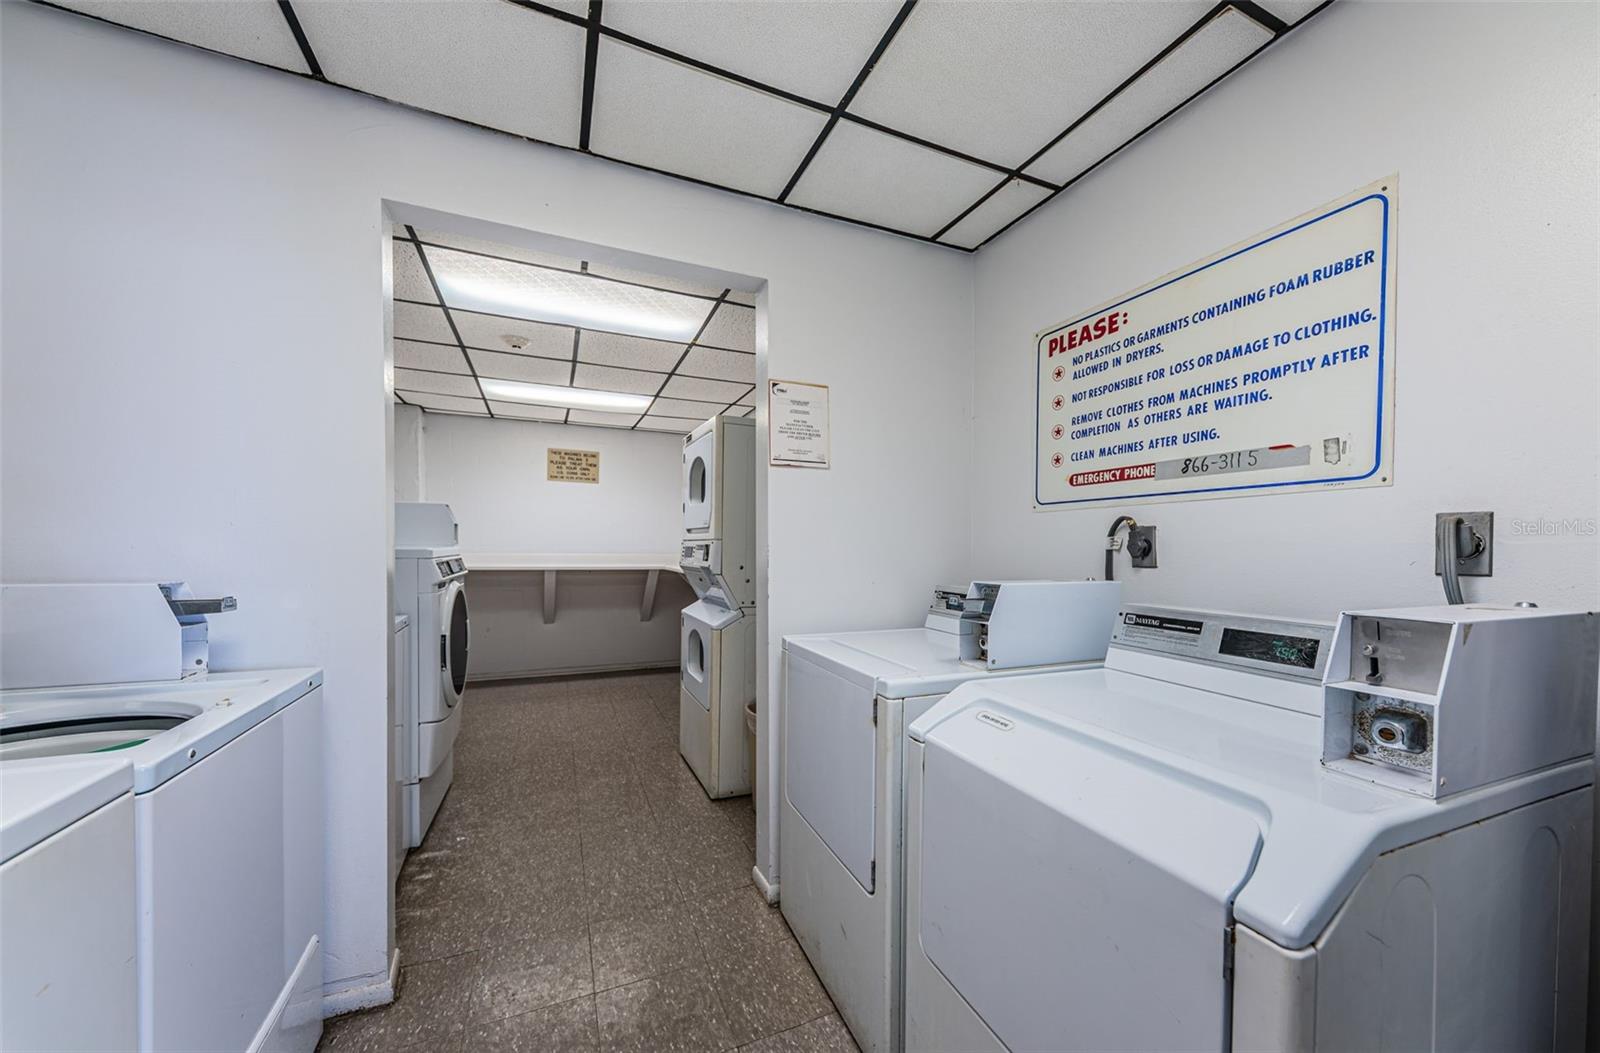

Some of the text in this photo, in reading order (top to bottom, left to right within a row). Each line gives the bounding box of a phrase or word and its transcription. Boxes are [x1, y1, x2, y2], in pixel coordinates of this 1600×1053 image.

[1072, 249, 1375, 366] NO PLASTICS OR GARMENTS CONTAINING FOAM RUBBER
[1071, 308, 1377, 404] NOT RESPONSIBLE FOR LOSS OR DAMAGE TO CLOTHING.
[1072, 343, 1164, 381] ALLOWED IN DRYERS.
[1071, 344, 1370, 426] REMOVE CLOTHES FROM MACHINES PROMPTLY AFTER
[1070, 388, 1273, 441] COMPLETION AS OTHERS ARE WAITING.
[1070, 428, 1221, 462] CLEAN MACHINES AFTER USING.
[1072, 464, 1156, 486] EMERGENCY PHONE
[1135, 617, 1161, 626] MAYTAG
